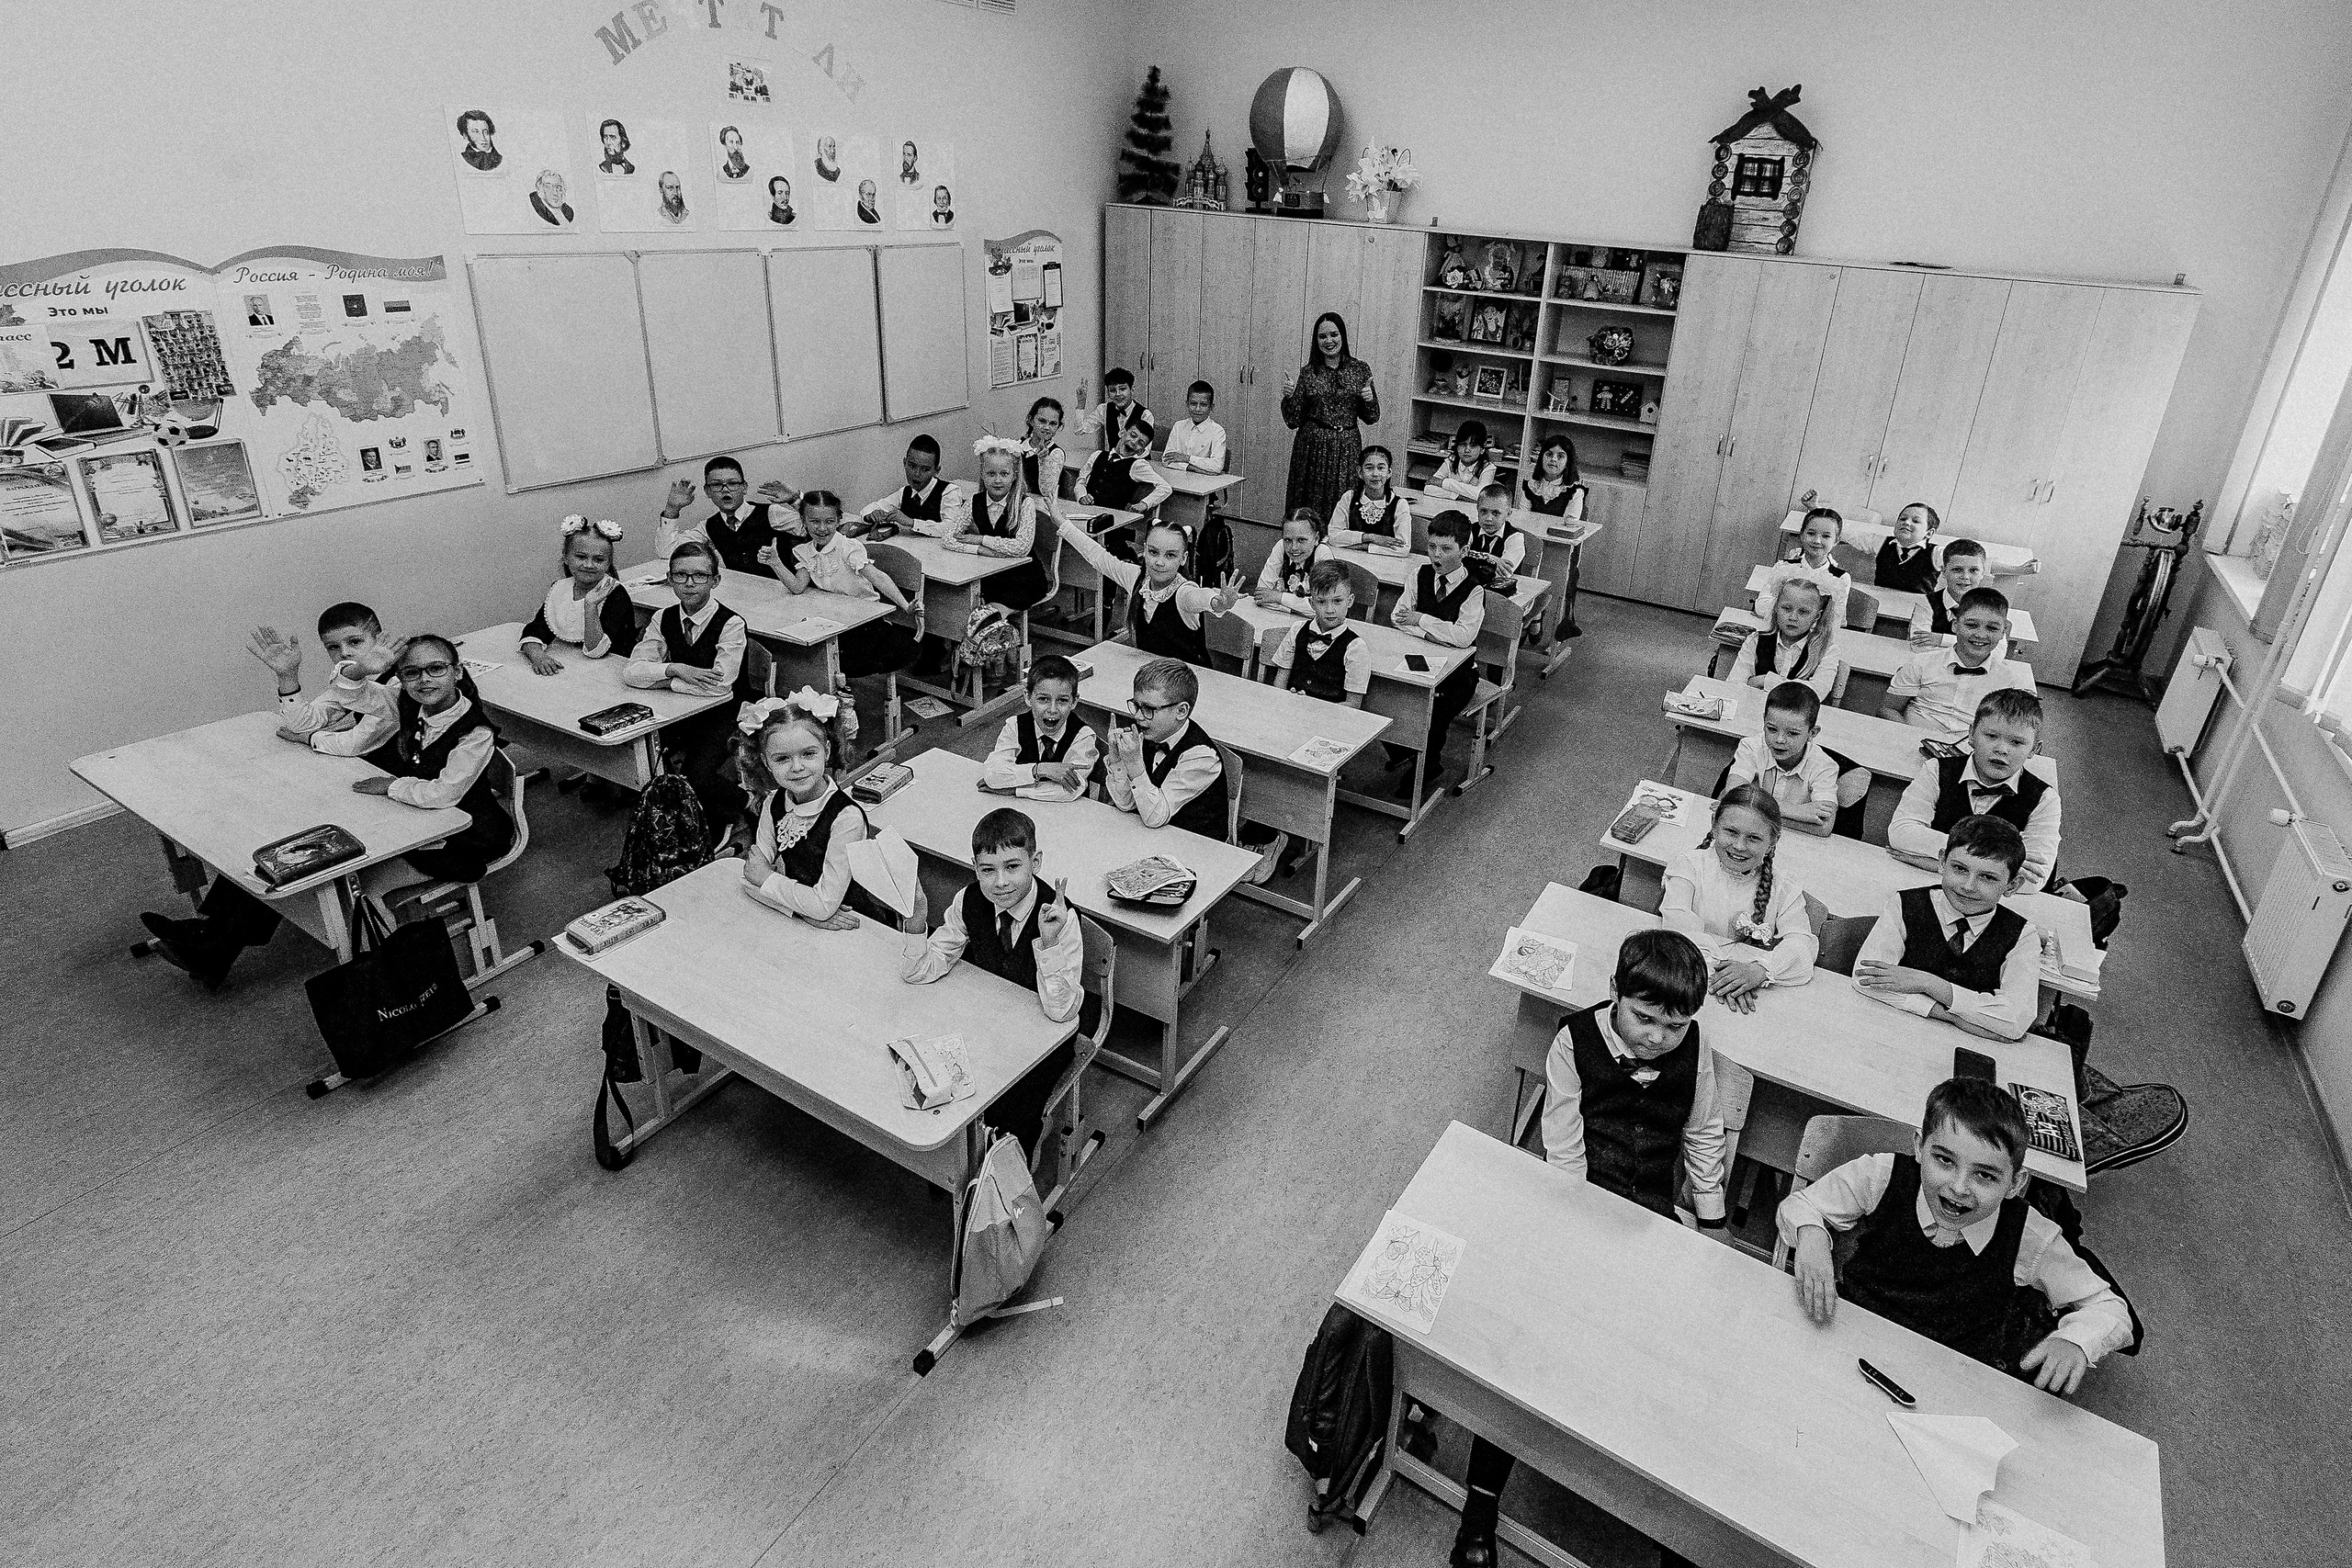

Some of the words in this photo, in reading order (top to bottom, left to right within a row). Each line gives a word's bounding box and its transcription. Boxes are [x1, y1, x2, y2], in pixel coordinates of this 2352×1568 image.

[233, 265, 300, 284] Россия
[325, 264, 387, 284] Родина
[394, 260, 435, 278] моя!
[0, 275, 91, 298] ссный
[106, 277, 186, 300] уголок
[48, 307, 77, 318] Это
[83, 306, 108, 316] мы
[89, 336, 138, 367] М
